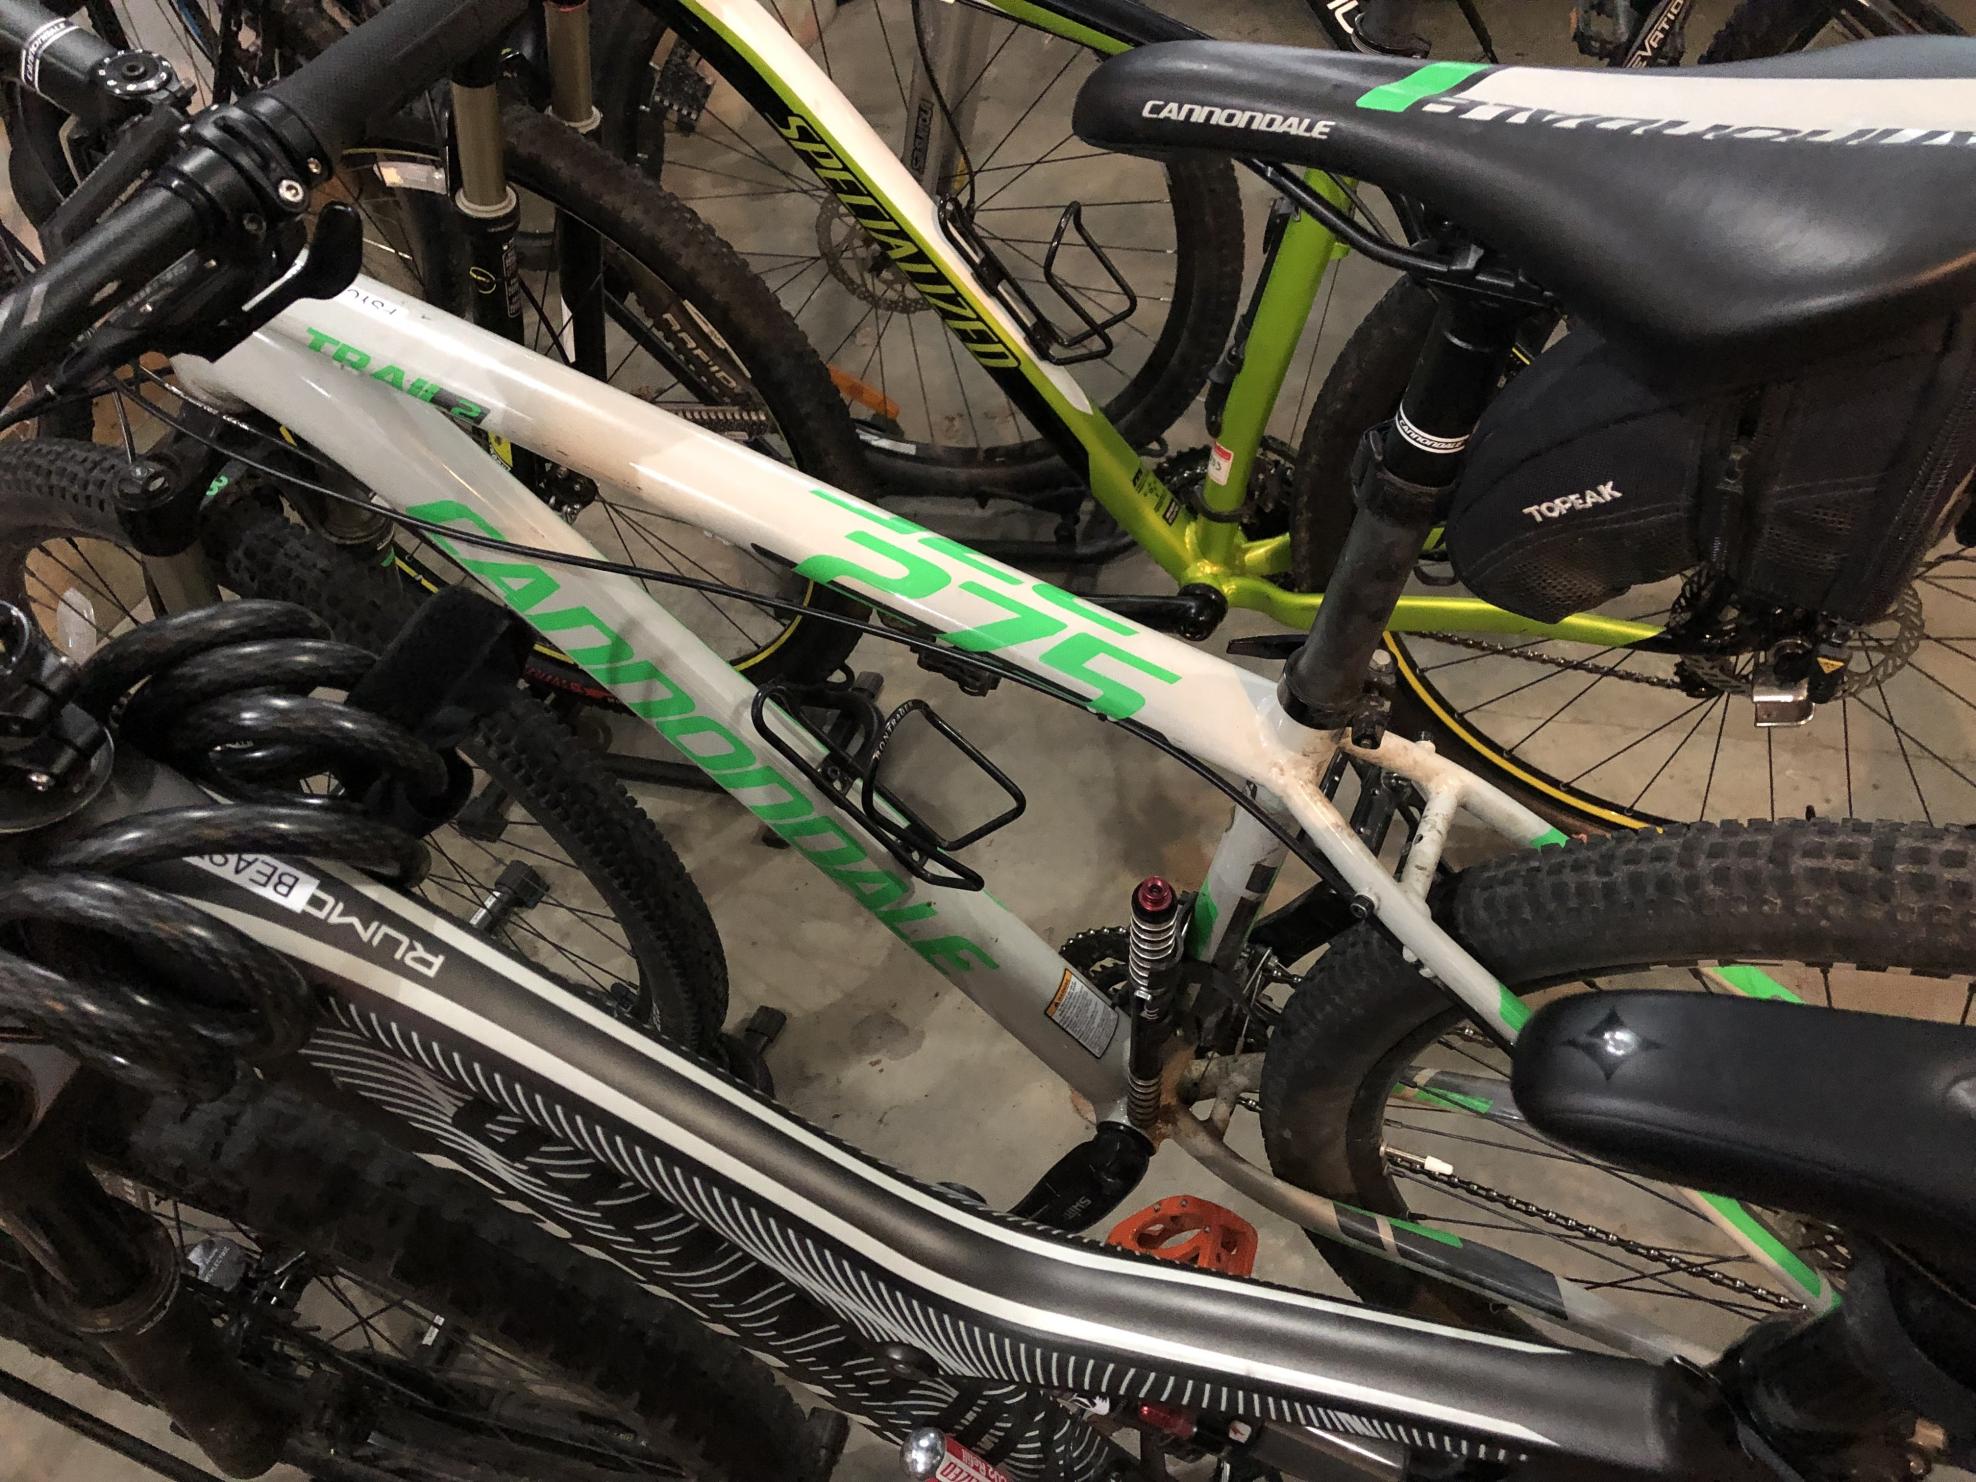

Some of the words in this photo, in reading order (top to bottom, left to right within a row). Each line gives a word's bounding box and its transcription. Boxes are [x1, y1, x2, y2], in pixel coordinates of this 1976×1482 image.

[1142, 100, 1336, 140] CANNONDALE
[764, 112, 1021, 368] SPECIALIZED
[307, 327, 441, 404] TRAIL
[451, 399, 482, 418] 2
[1522, 481, 1623, 523] TOPEAK
[405, 499, 1000, 974] CANNONDALE
